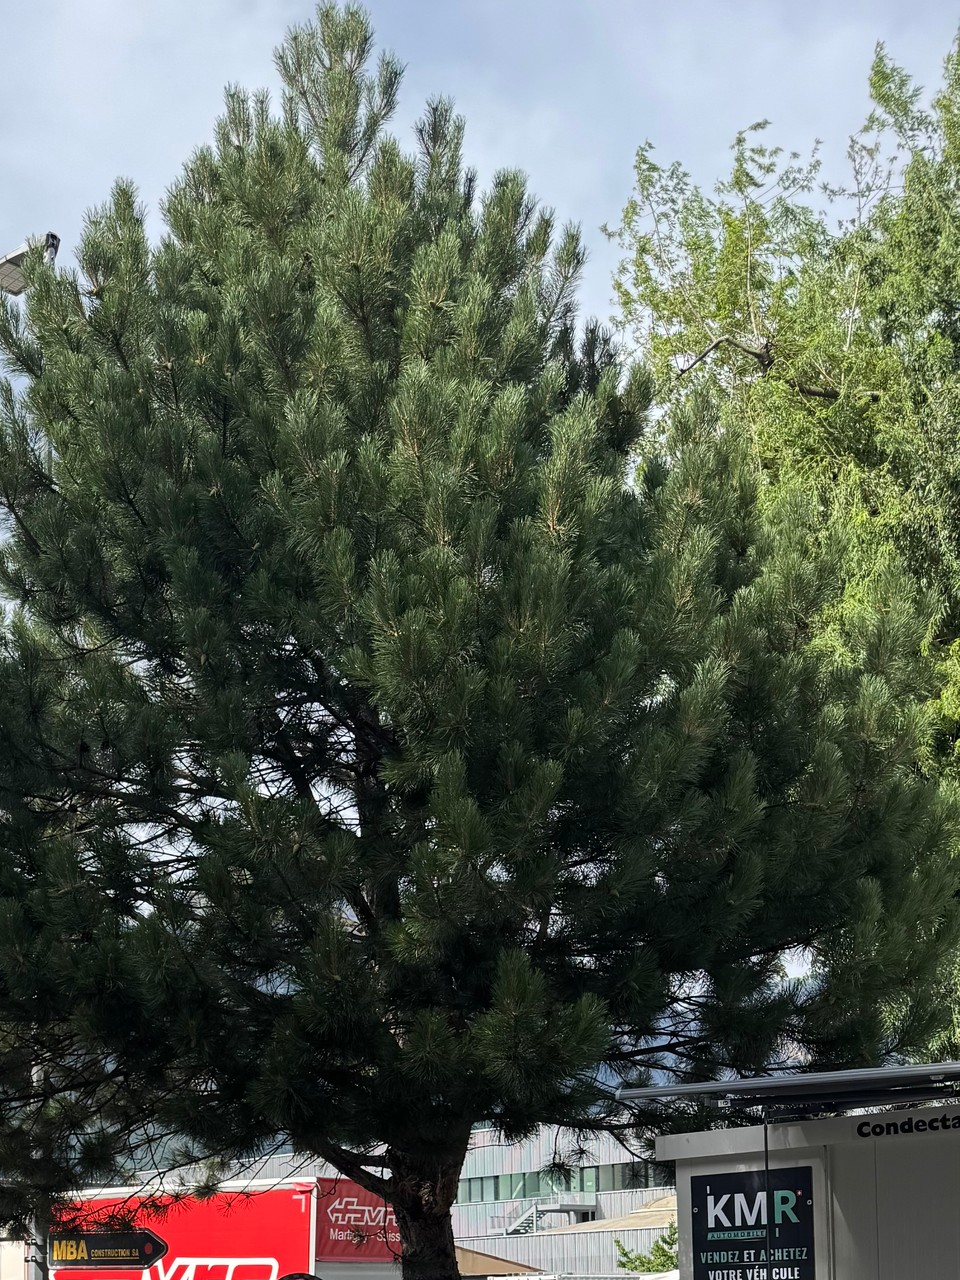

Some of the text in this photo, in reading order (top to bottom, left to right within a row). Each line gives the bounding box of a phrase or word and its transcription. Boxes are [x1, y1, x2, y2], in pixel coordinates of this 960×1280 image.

[707, 1189, 800, 1228] KMR
[711, 1231, 765, 1239] AUTOMOBILE
[53, 1240, 139, 1260] MBA CONSTRUCTION SA
[700, 1251, 739, 1263] VENDEZ
[744, 1250, 755, 1261] ET
[709, 1265, 800, 1280] VOTRE VÉHCULE
